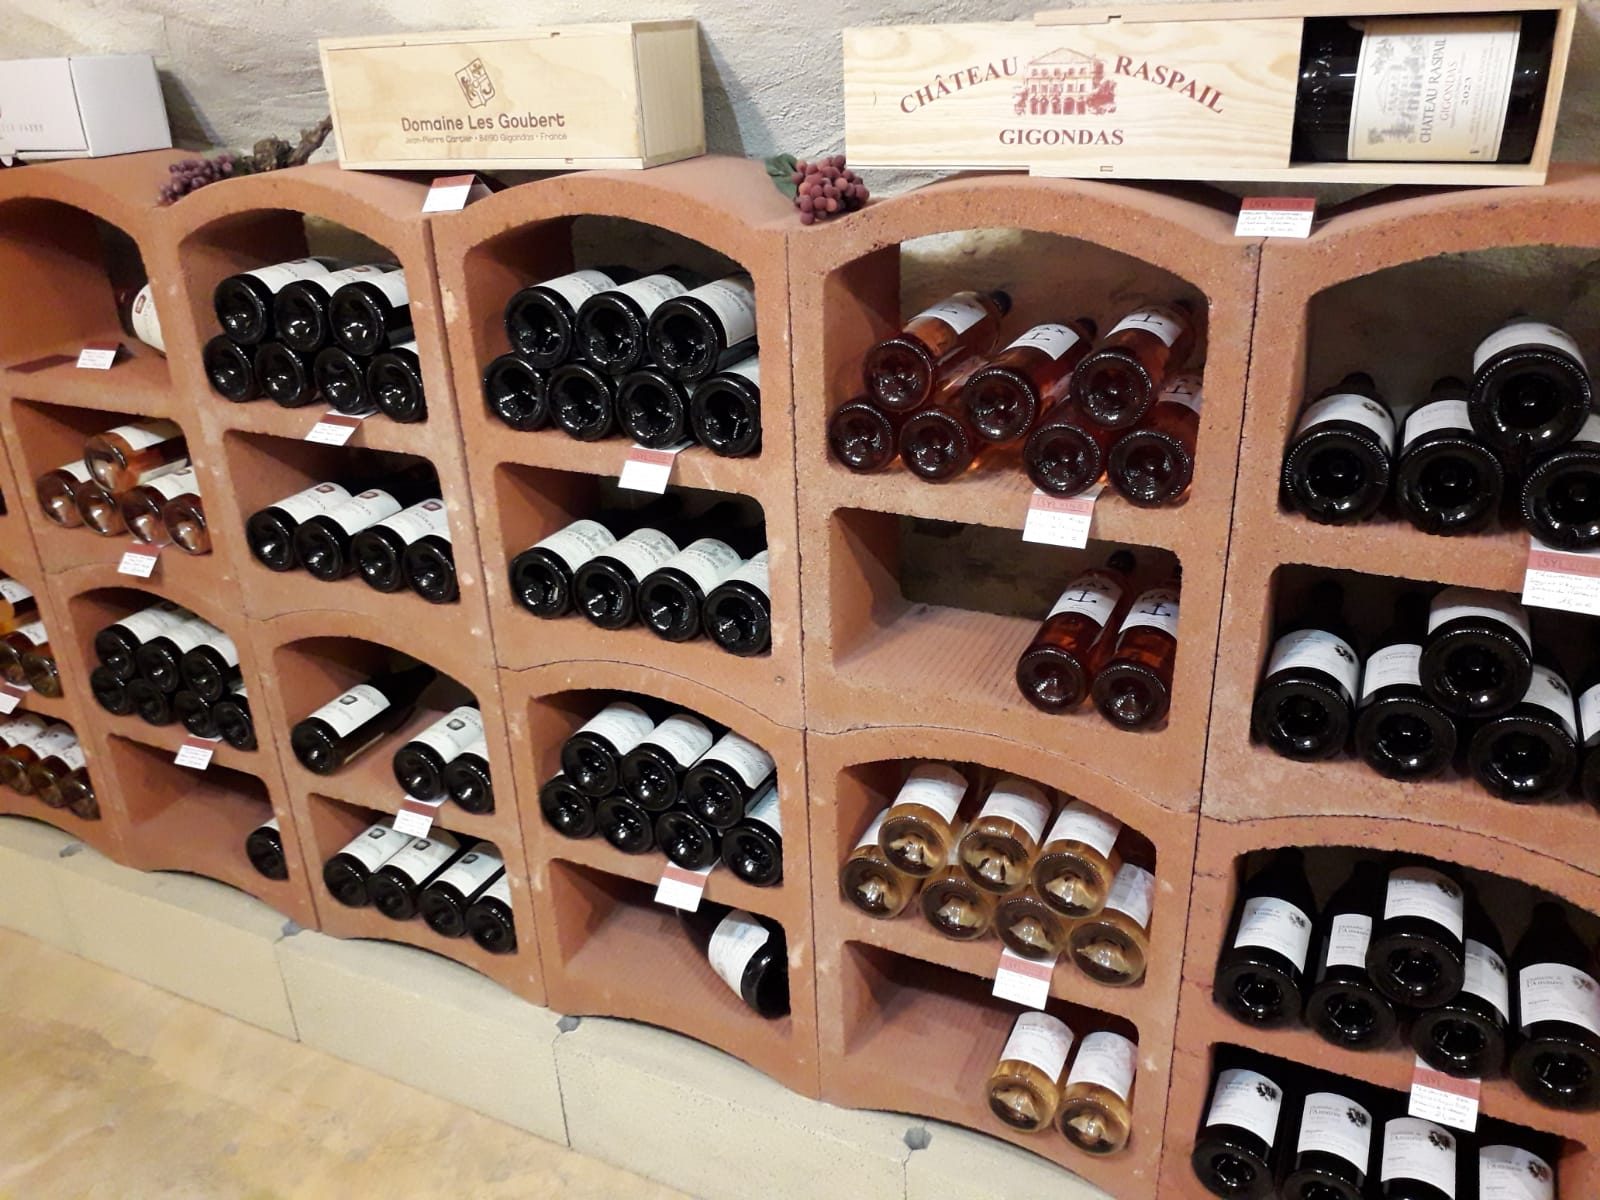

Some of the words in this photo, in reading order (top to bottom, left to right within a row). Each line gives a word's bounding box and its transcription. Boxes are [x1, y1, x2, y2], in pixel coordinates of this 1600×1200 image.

[900, 56, 1018, 114] CHÂTEAU
[1114, 55, 1224, 114] RASPAIL
[1419, 88, 1438, 143] CHATEAU
[1429, 38, 1447, 86] RASPAIL
[1440, 61, 1458, 121] GIGONDAS
[401, 115, 464, 132] Domaine
[467, 115, 494, 130] Les
[498, 112, 565, 129] Goubert
[999, 129, 1124, 145] GIGONDAS
